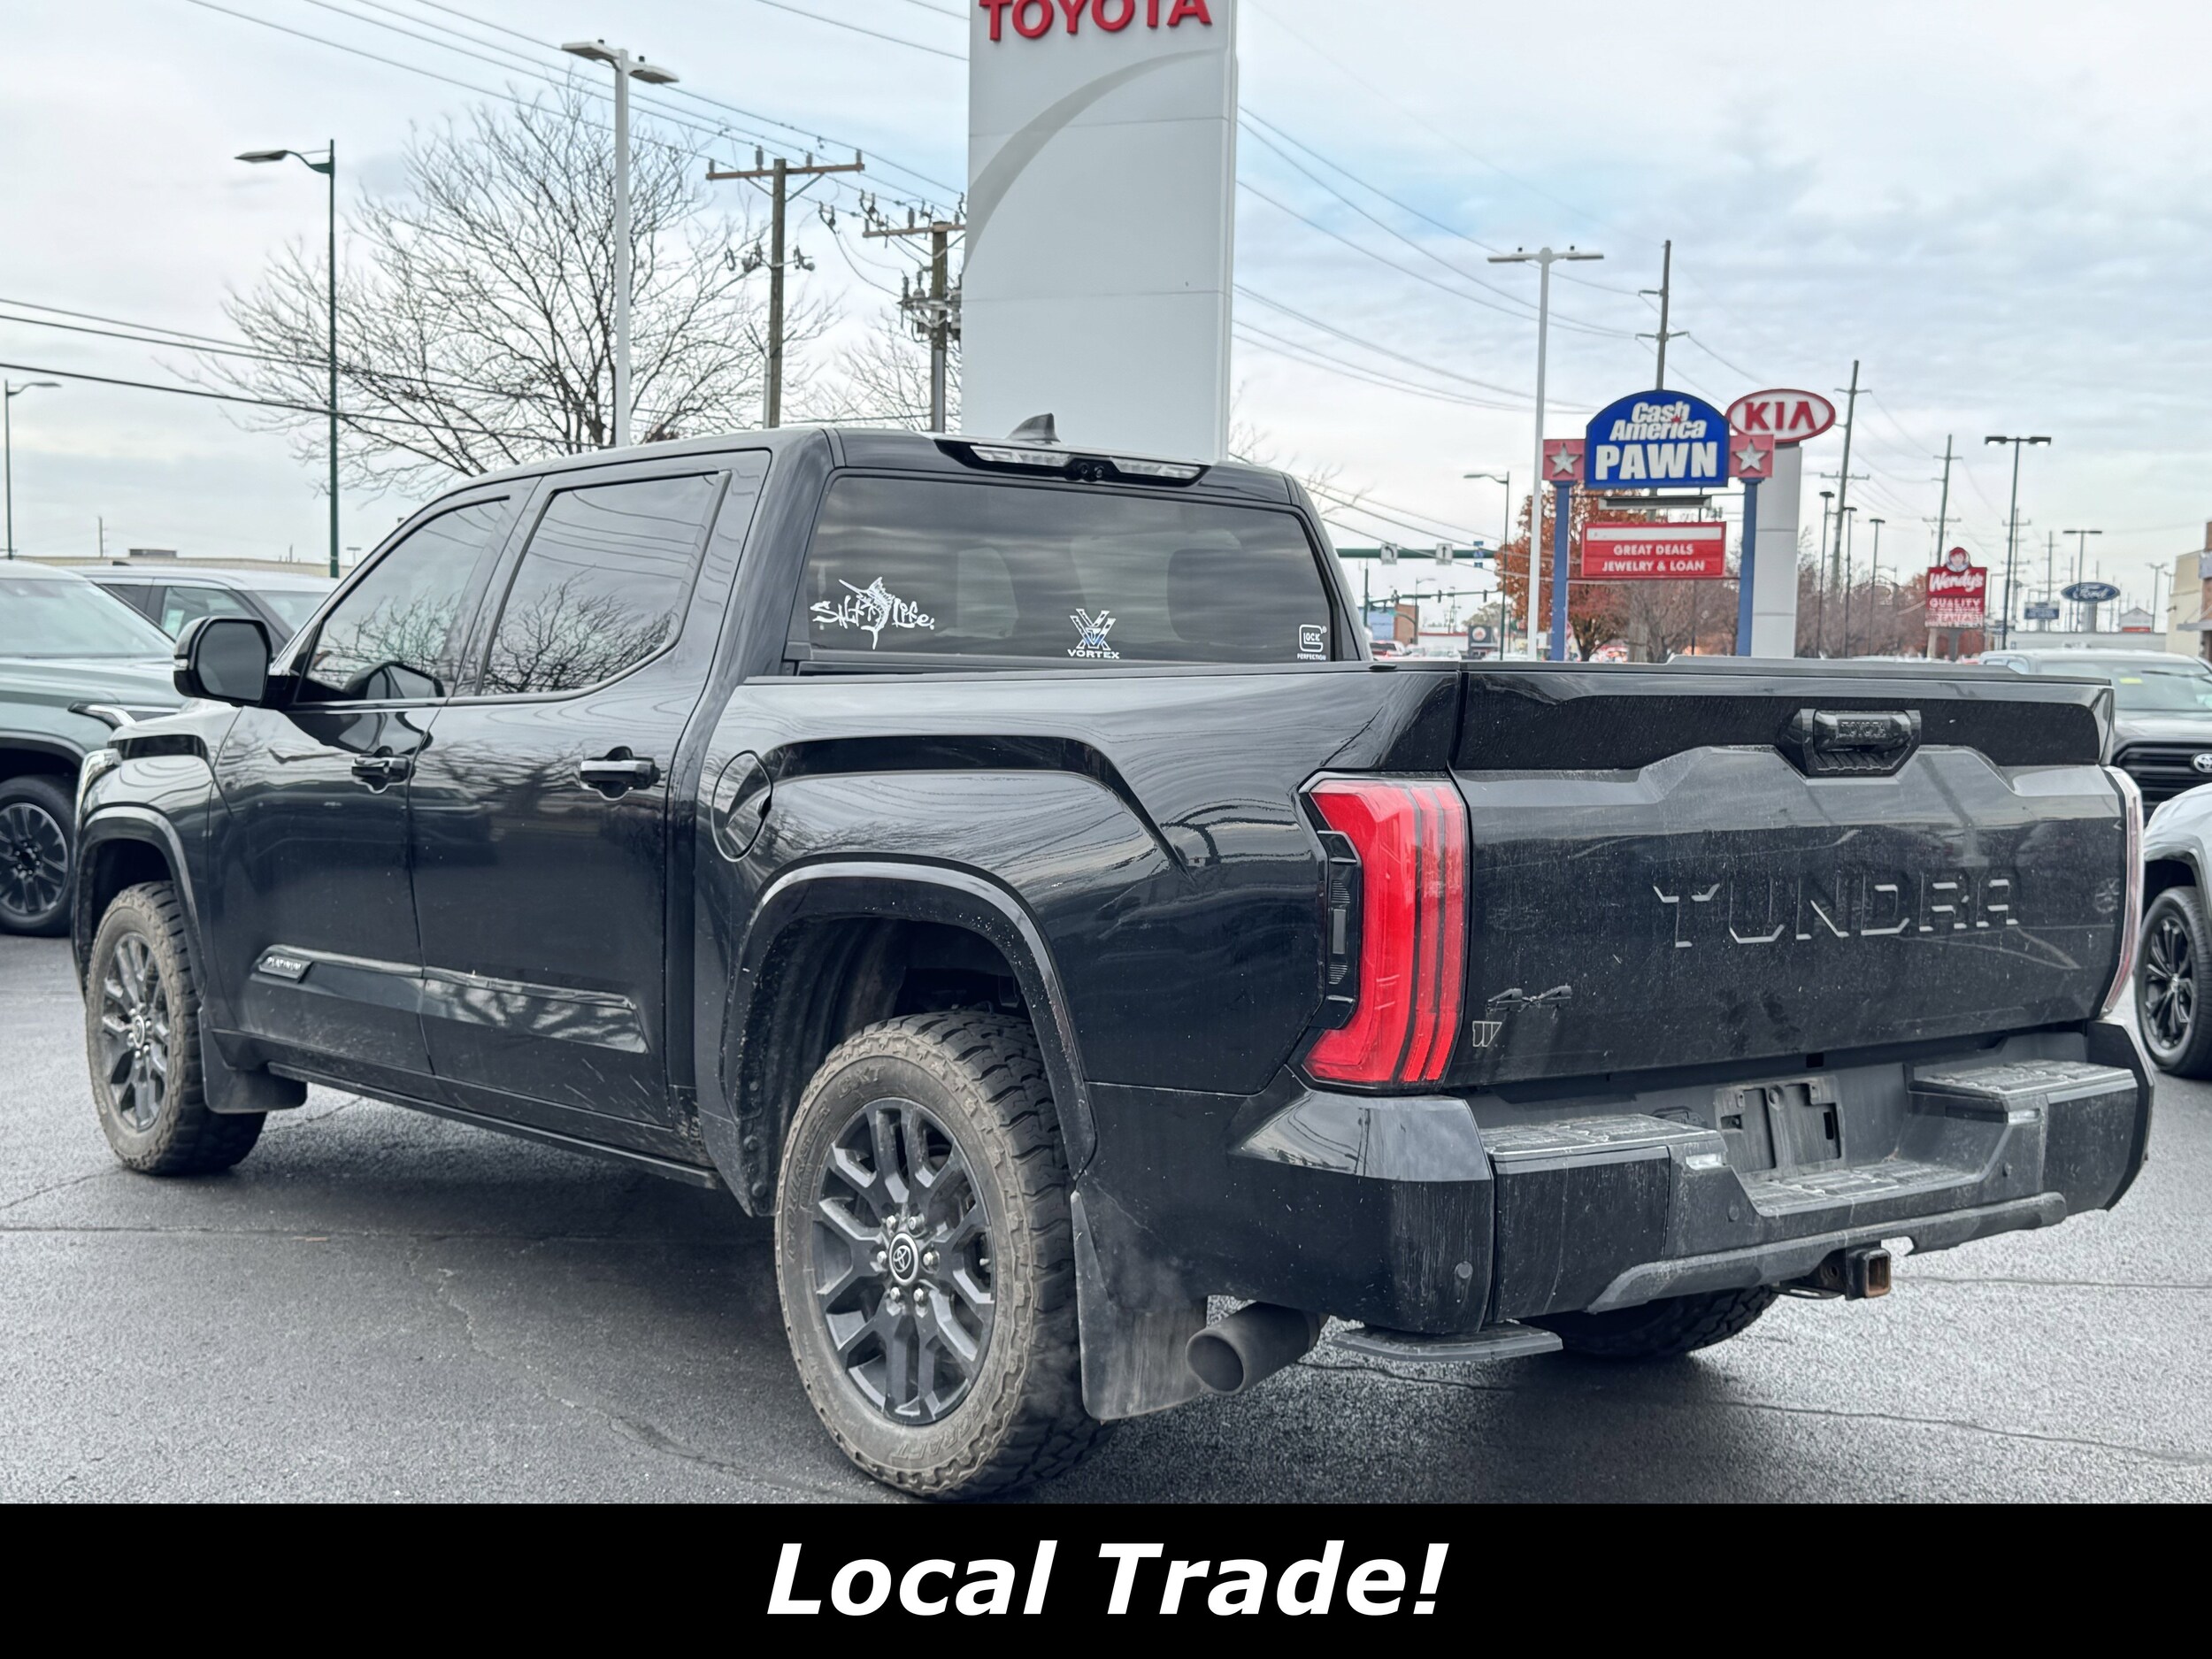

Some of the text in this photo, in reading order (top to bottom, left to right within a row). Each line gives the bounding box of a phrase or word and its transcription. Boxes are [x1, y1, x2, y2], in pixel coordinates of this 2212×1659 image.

[979, 0, 1212, 42] TOYOTA
[1632, 401, 1690, 424] Cash
[1745, 401, 1816, 431] KIA
[1609, 419, 1708, 441] America
[1595, 442, 1717, 480] PAWN
[1614, 543, 1694, 556] GREAT DEALS
[1602, 560, 1705, 572] JEWELRY & LOAN
[1930, 570, 1984, 592] Wendy's
[2072, 586, 2110, 600] Ford
[1930, 597, 1982, 609] QUALITY
[1067, 649, 1120, 659] VORTEX
[267, 956, 302, 971] PLATINUM
